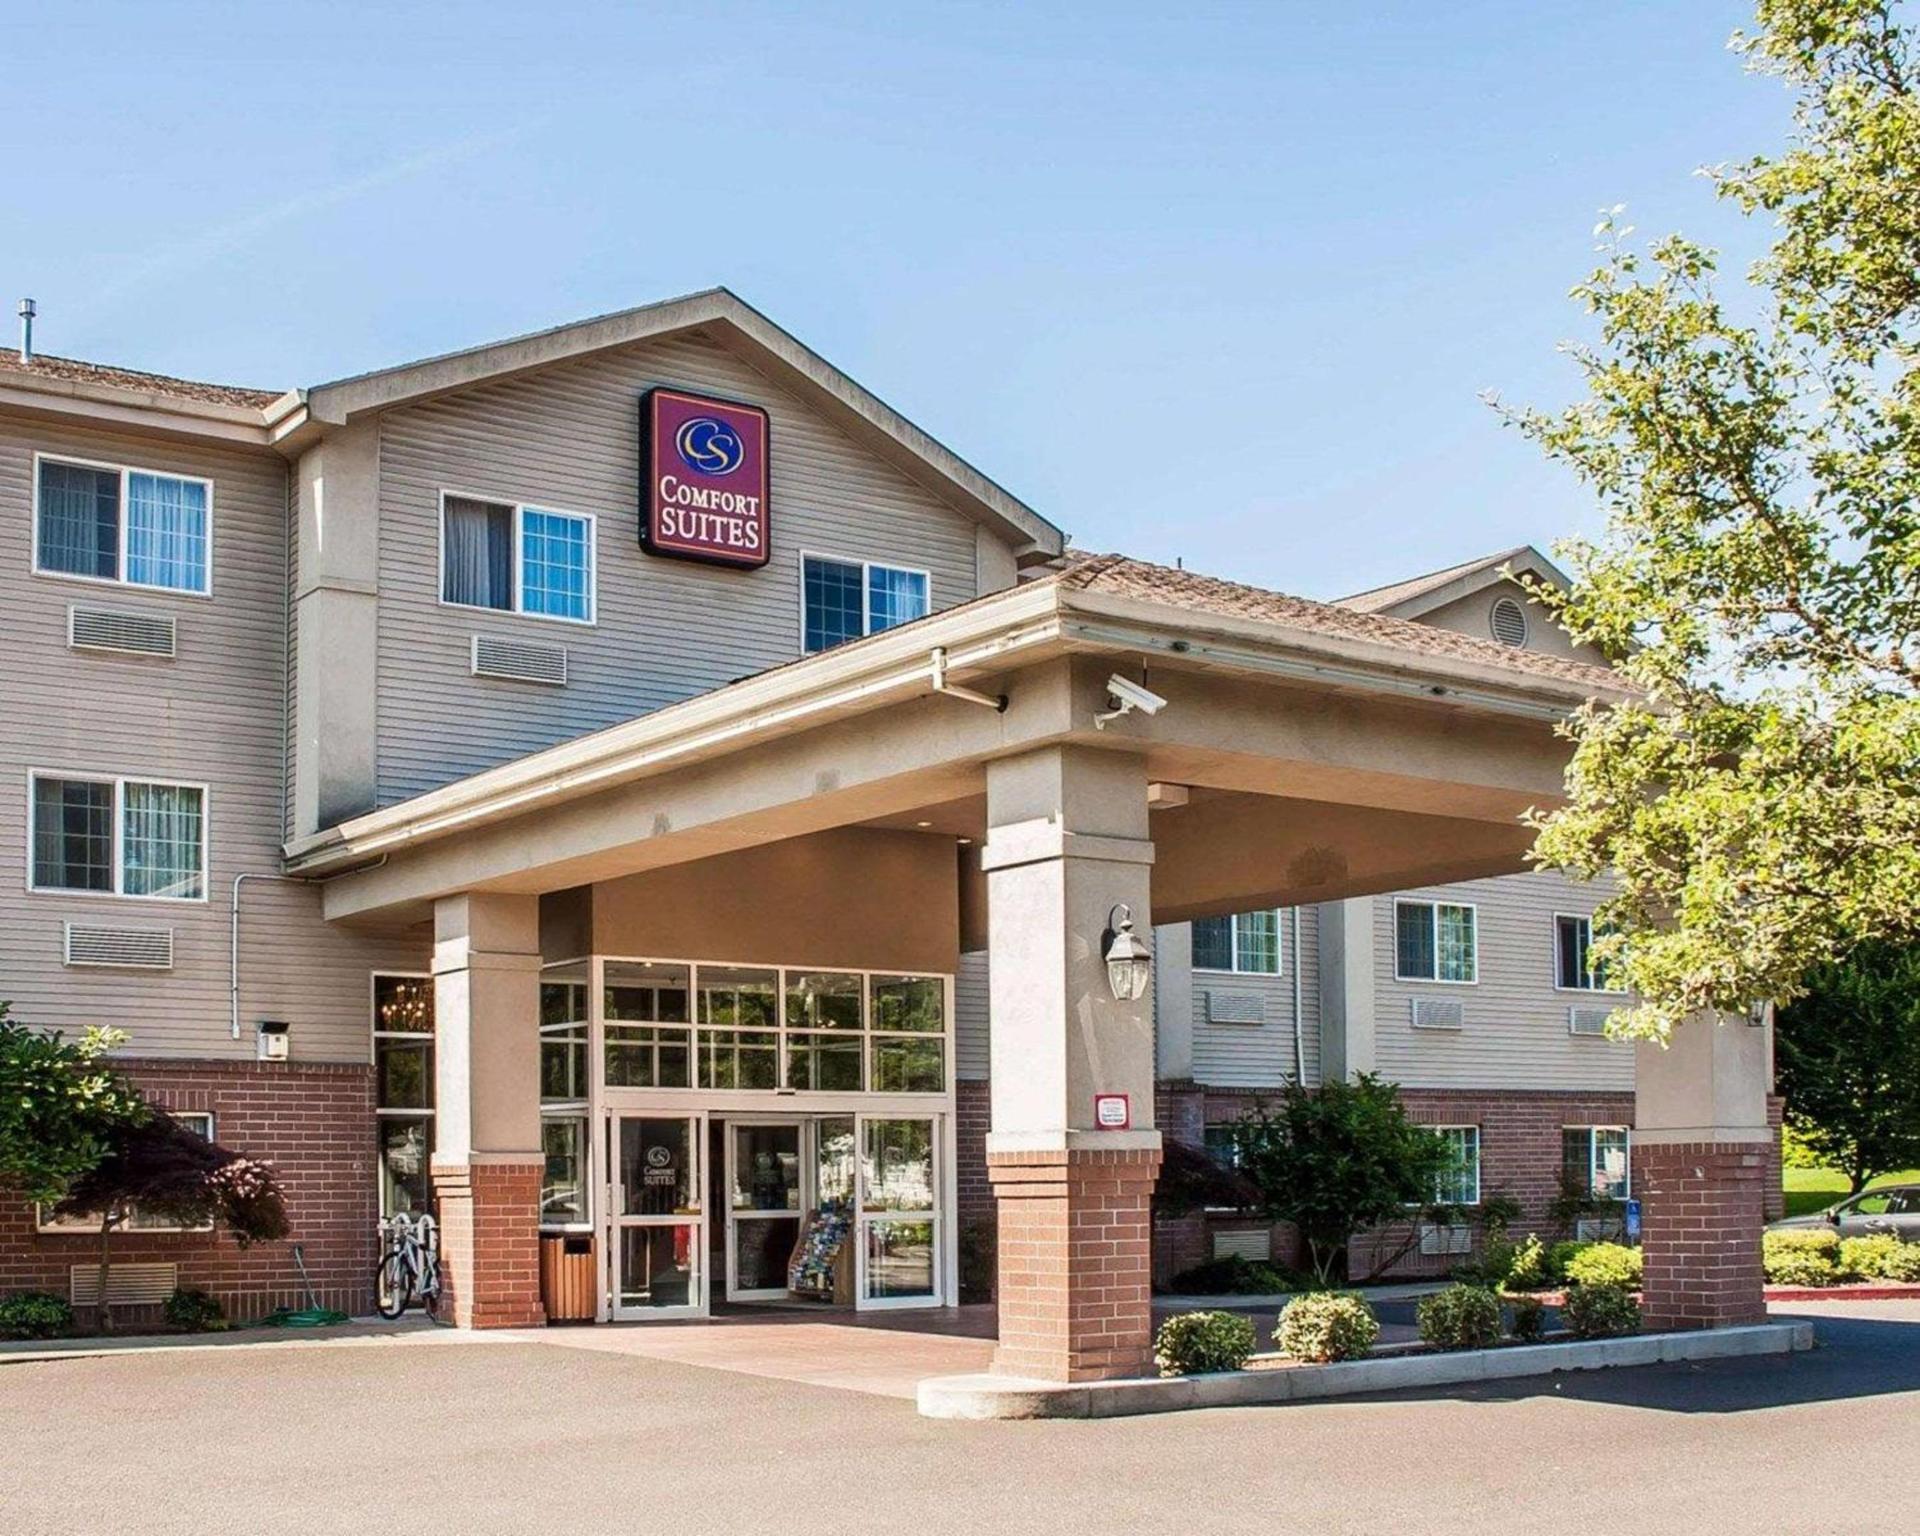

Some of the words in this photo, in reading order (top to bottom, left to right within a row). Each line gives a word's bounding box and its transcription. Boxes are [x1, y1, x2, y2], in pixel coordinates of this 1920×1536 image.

[684, 421, 733, 471] CS
[660, 475, 759, 516] COMFORT
[660, 507, 759, 548] SUITES
